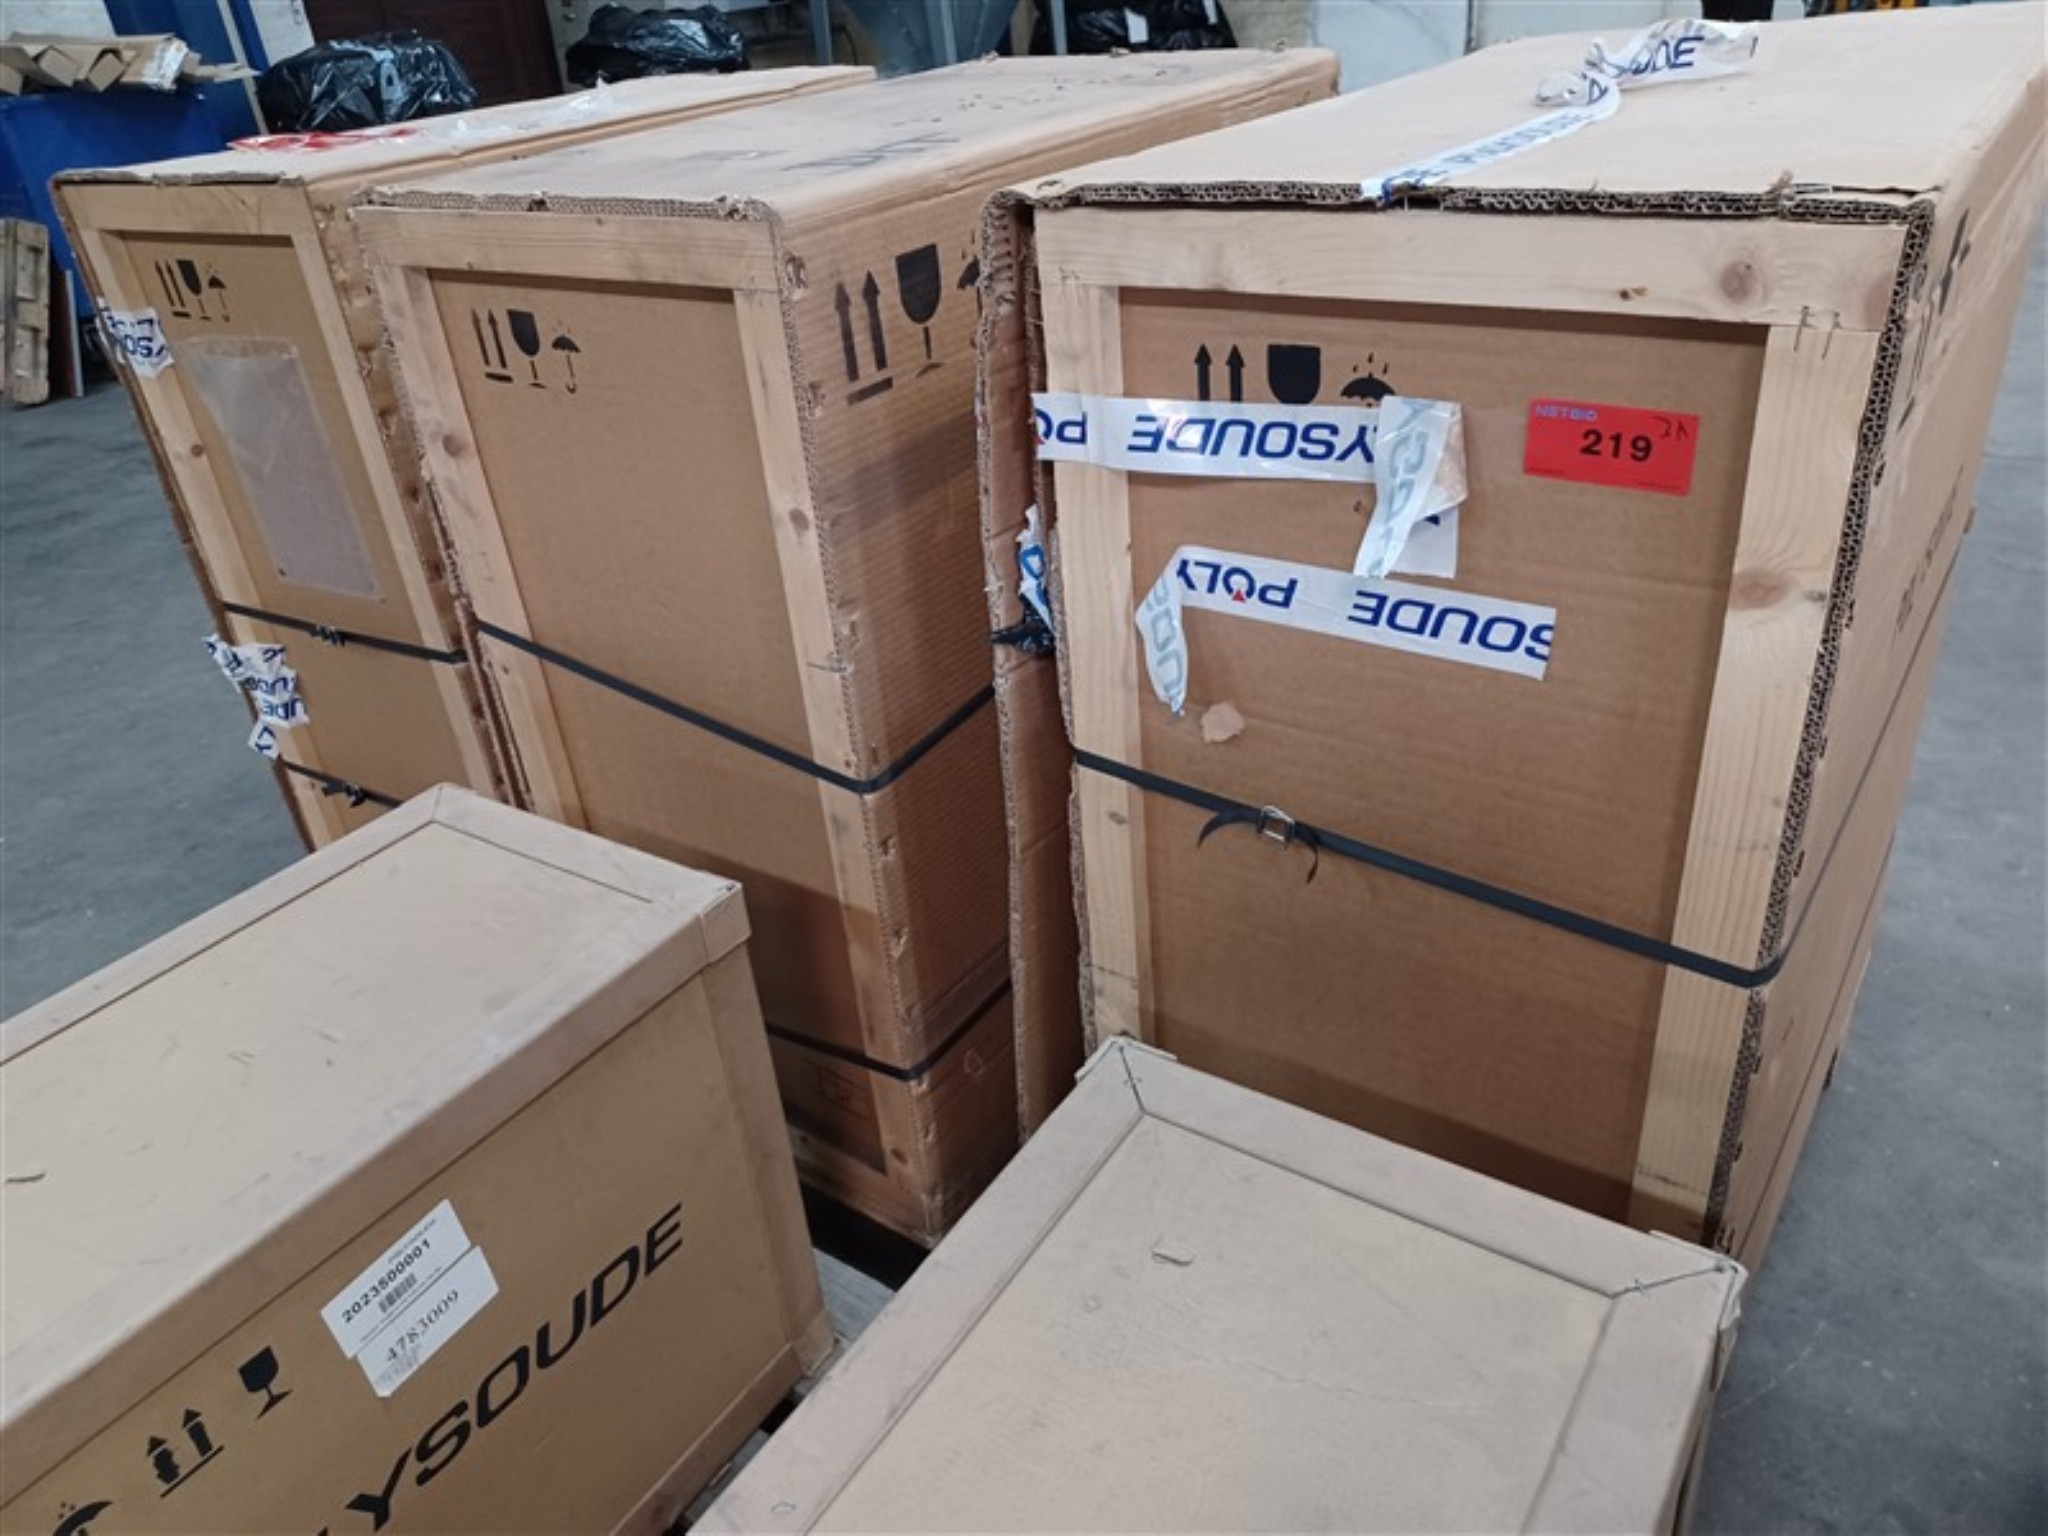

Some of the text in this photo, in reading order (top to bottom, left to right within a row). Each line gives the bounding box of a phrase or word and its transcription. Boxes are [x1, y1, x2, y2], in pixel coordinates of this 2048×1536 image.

[1126, 414, 1378, 464] YSOUDE
[1579, 428, 1653, 462] 219
[1176, 558, 1298, 610] POLY
[341, 1239, 431, 1324] 2023500001
[387, 1289, 459, 1362] 4783009
[318, 1202, 684, 1536] YSOUDE
